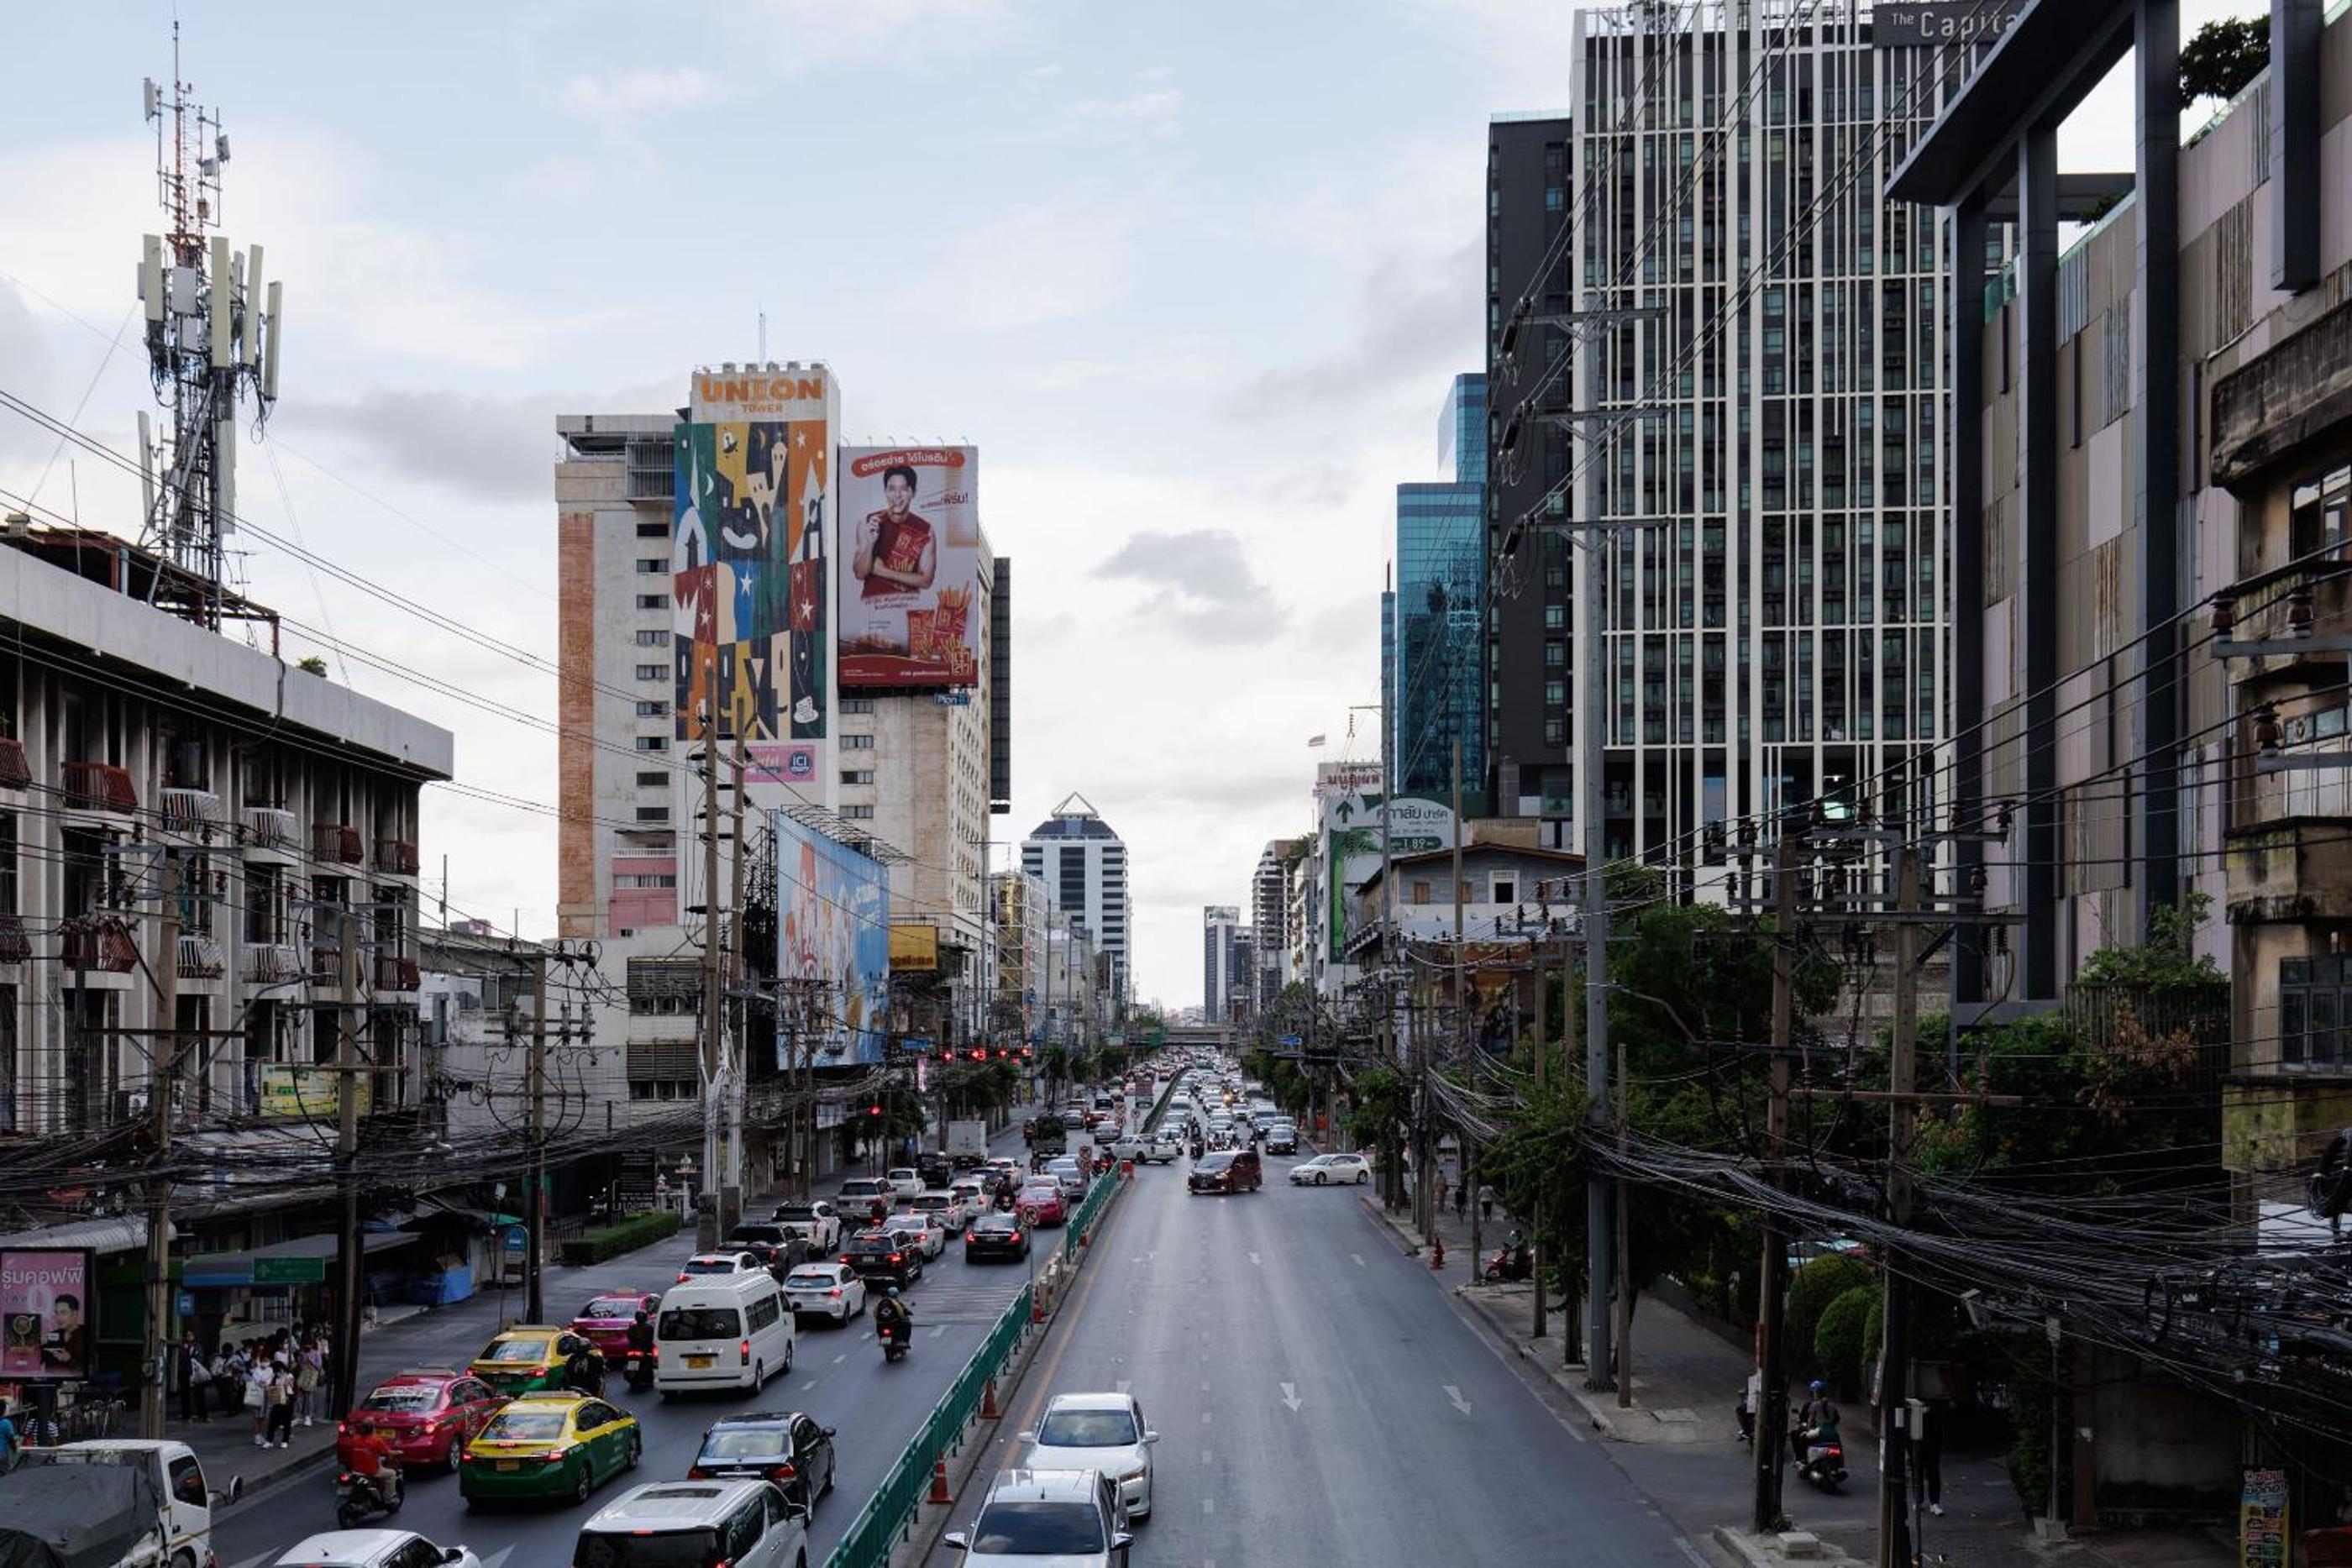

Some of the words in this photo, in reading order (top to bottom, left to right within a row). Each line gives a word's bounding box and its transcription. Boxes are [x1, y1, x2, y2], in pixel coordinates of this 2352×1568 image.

[1892, 13, 1914, 26] The
[701, 378, 822, 402] UNION
[742, 404, 784, 412] TOWER
